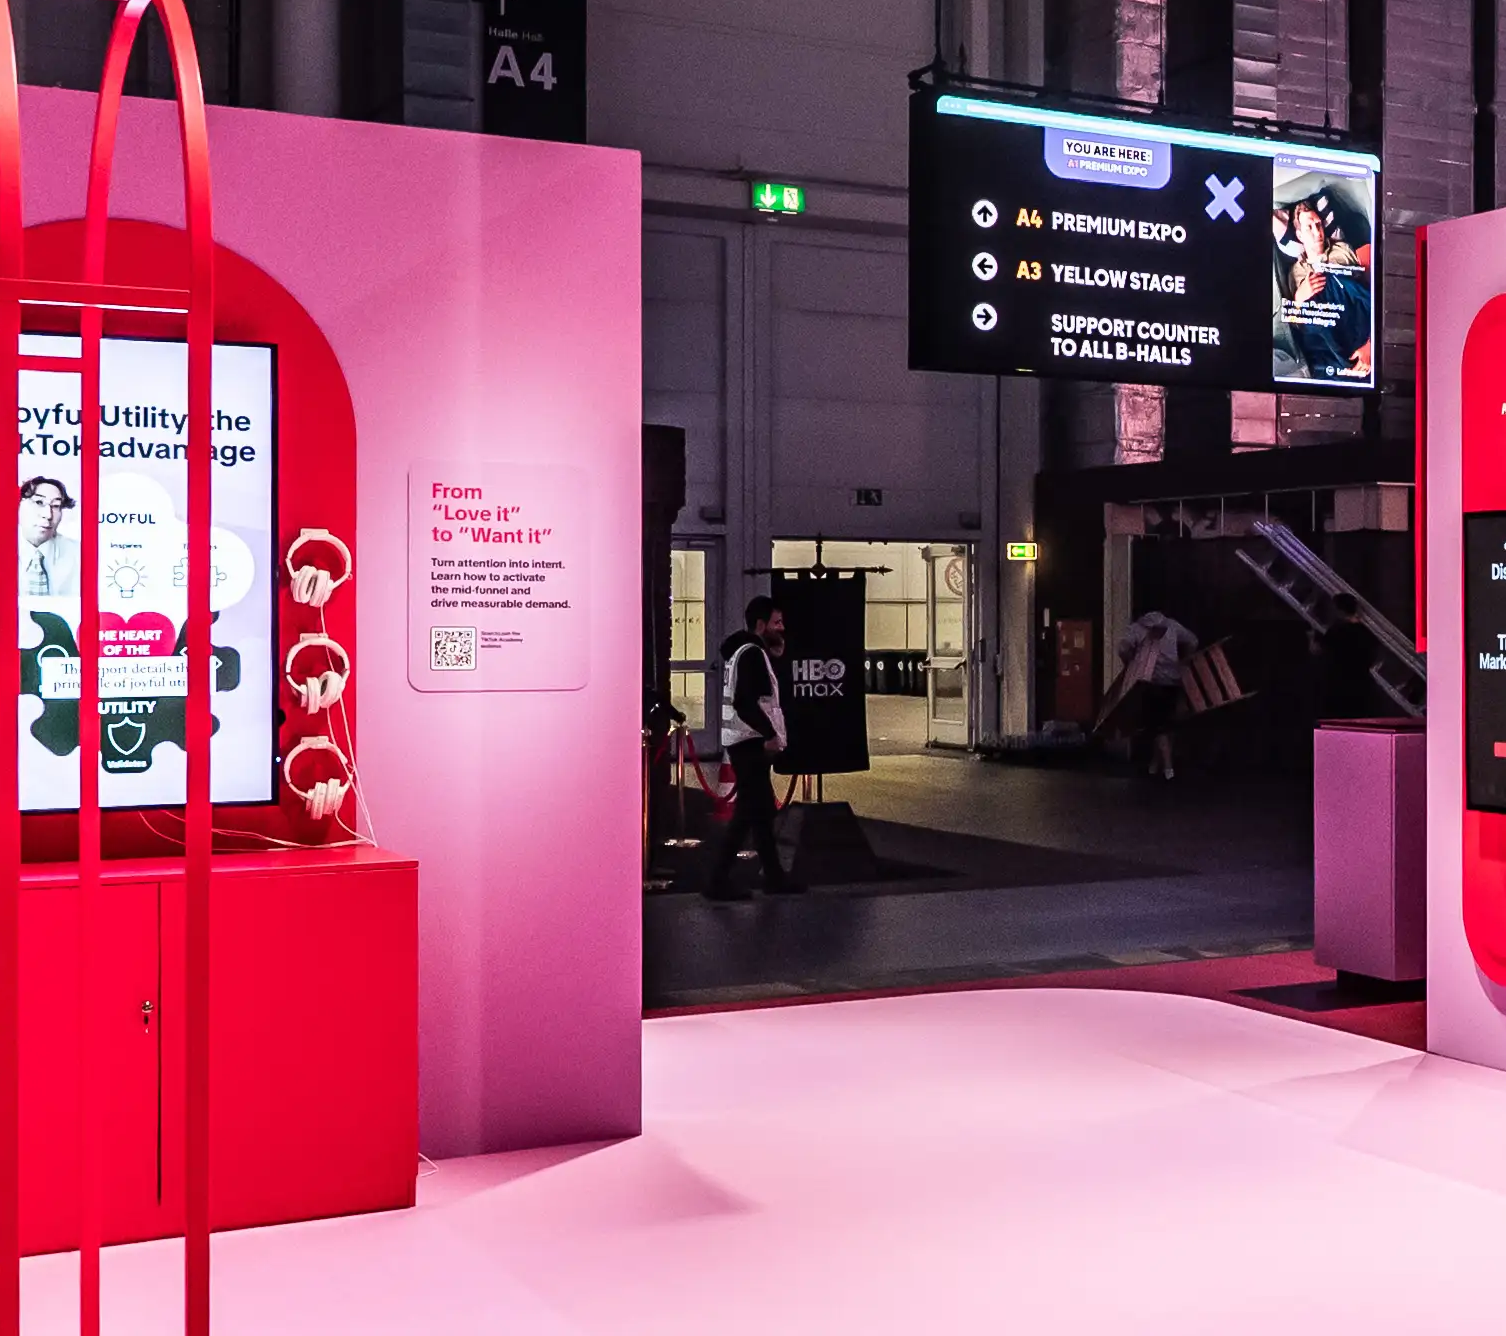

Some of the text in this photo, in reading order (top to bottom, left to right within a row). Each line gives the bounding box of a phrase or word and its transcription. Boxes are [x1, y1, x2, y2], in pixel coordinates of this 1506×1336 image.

[488, 26, 519, 40] Halle
[487, 45, 558, 92] A4
[1066, 141, 1151, 162] YOU ARE HERE:
[1079, 159, 1122, 175] PREMIUM
[1123, 164, 1148, 177] EXPO
[1016, 207, 1187, 244] A4 PREMIUM EXPO
[1016, 260, 1186, 295] A3 YELLOW STAGE
[1051, 313, 1221, 346] SUPPORT COUNTER
[1050, 336, 1192, 366] TO ALL B-HALLS
[17, 402, 82, 430] oyfu
[100, 437, 256, 467] advanage
[431, 482, 483, 500] From
[98, 512, 156, 525] JOYFUL
[431, 527, 453, 542] to
[431, 557, 566, 570] Turn attention into intent.
[431, 571, 546, 583] Learn how to activate
[431, 585, 531, 595] the mid-funnel and
[430, 598, 572, 609] drive measurable demand.
[98, 630, 163, 642] HE HEART
[103, 644, 151, 656] OF THE
[131, 662, 172, 675] details
[792, 658, 846, 681] HBO
[129, 676, 166, 692] joyful
[793, 682, 844, 698] max
[97, 700, 157, 715] UTILITY
